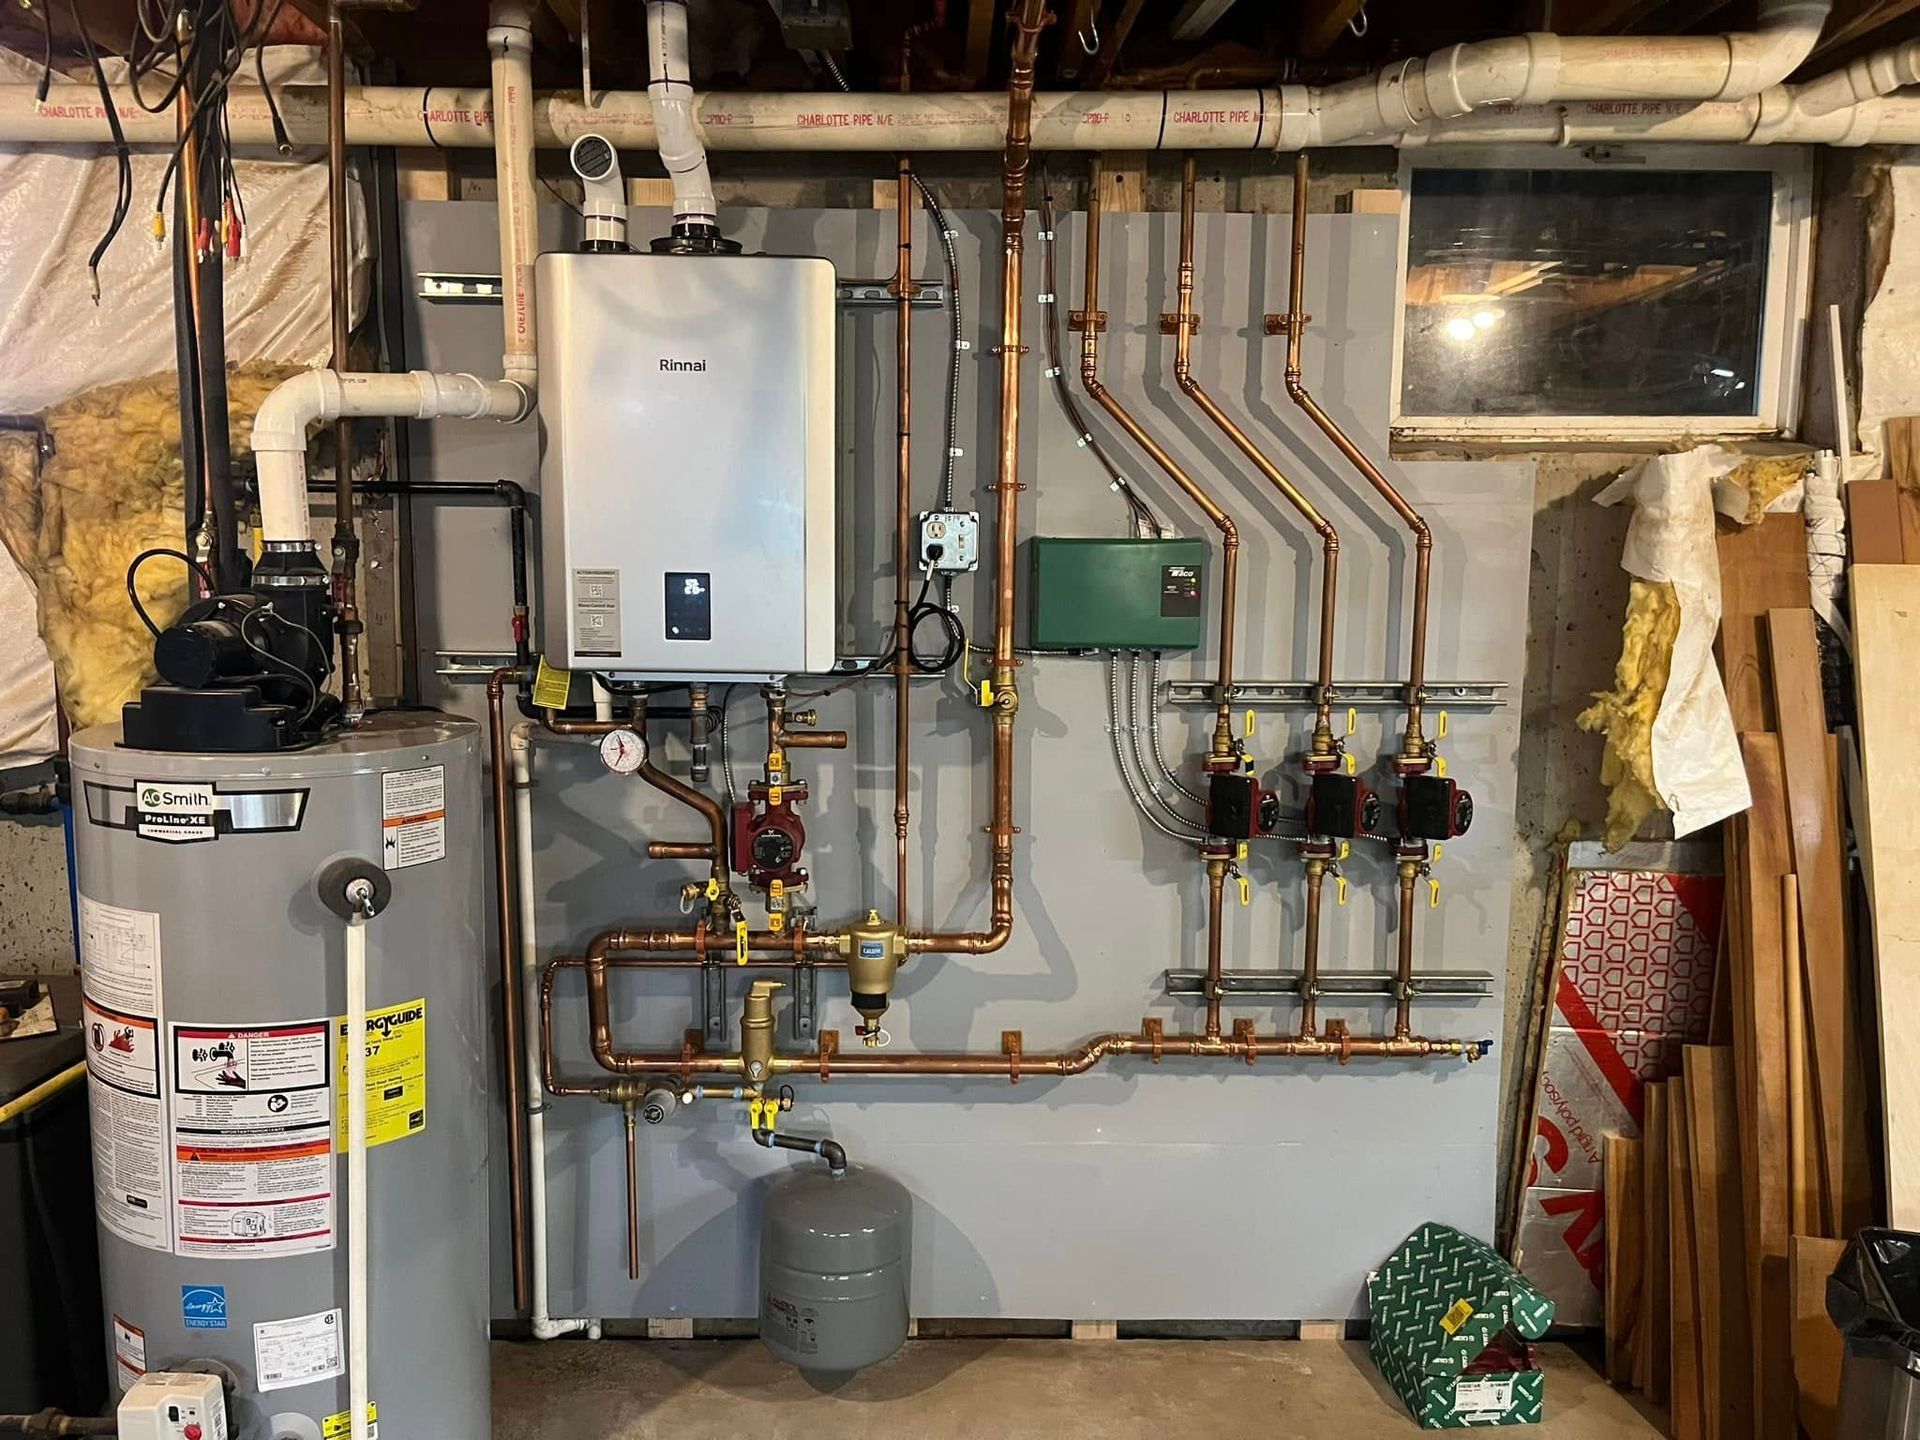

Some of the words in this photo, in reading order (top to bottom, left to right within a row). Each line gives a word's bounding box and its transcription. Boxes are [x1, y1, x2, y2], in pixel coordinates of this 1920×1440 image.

[39, 106, 92, 118] CHARLOTTE
[1586, 102, 1639, 115] CHARLOTTE
[1640, 102, 1662, 115] PIPE
[417, 110, 471, 122] CARLOTTE
[474, 110, 494, 122] PIPE
[797, 114, 850, 126] CHARLOTTE
[853, 114, 873, 126] PIPE
[877, 114, 894, 126] N/E
[1174, 111, 1226, 123] CHARLOTTE
[1229, 110, 1249, 122] PIPE
[659, 359, 706, 372] Rinnai
[162, 791, 209, 806] Smith
[190, 816, 207, 825] XE
[339, 1007, 424, 1037] ERGYGUIDE
[238, 1031, 270, 1039] DANGER
[1541, 1070, 1581, 1133] polyisoc
